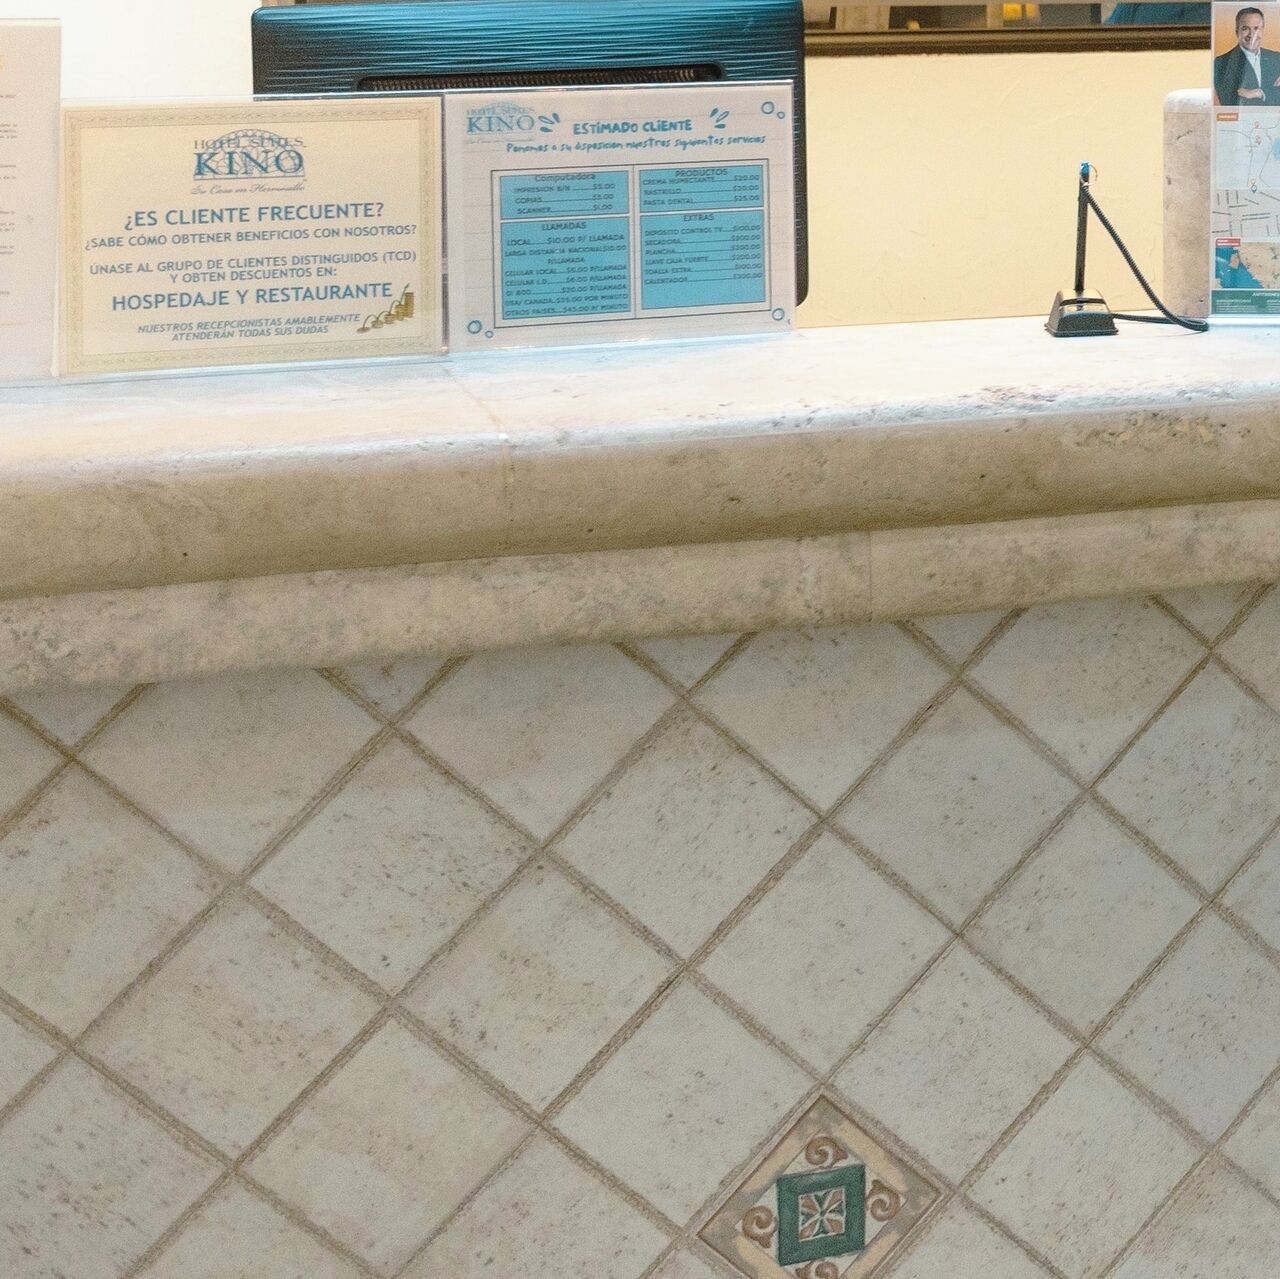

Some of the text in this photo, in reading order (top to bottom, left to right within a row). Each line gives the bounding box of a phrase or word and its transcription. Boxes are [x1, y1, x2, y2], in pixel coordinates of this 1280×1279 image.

[467, 115, 535, 132] KINO
[193, 149, 304, 176] KINO
[124, 201, 384, 231] ¿ES CLIENTE FRECUENTE?
[541, 221, 587, 231] LLAMADAS
[84, 223, 416, 250] ¿SABE CÓMO OBTENER BENEFICIOS CON NOSOTROS?
[89, 249, 416, 275] ÚNASE AL GRUPO DE CLIENTES DISTINGUIDOS (TCD)
[169, 266, 337, 283] Y OBTEN DESCUENTOS EN:
[112, 282, 392, 311] HOSPEDAJE Y RESTAURANTE
[137, 313, 361, 334] NUESTROS RECEPCIONISTAS AMABLEMENTE
[237, 327, 271, 338] TODAS
[273, 326, 293, 336] SUS
[294, 324, 329, 335] DUDAS
